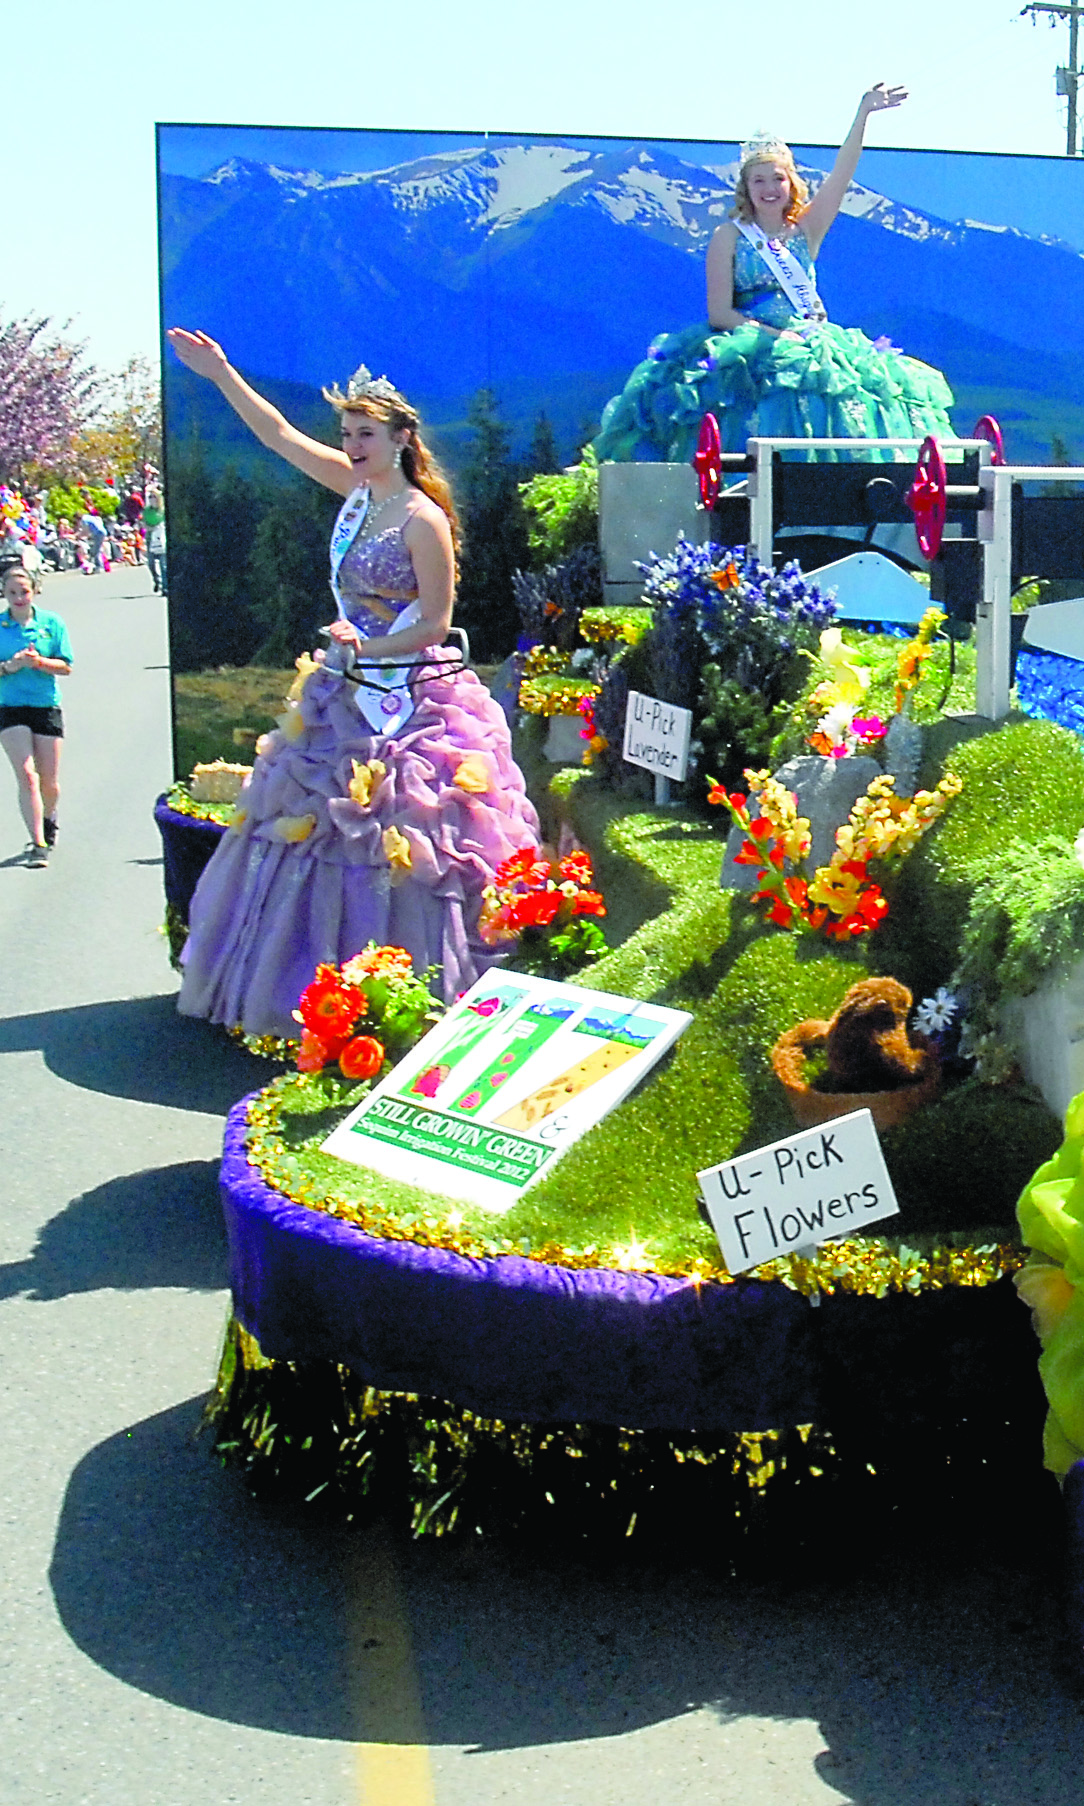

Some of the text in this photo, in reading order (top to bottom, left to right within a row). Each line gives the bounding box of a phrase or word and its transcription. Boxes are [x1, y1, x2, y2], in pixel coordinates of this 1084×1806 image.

[357, 1116, 530, 1180] Sequim Irrigation Festival 2012
[368, 1098, 412, 1126] STILL
[486, 1135, 553, 1168] GREEN
